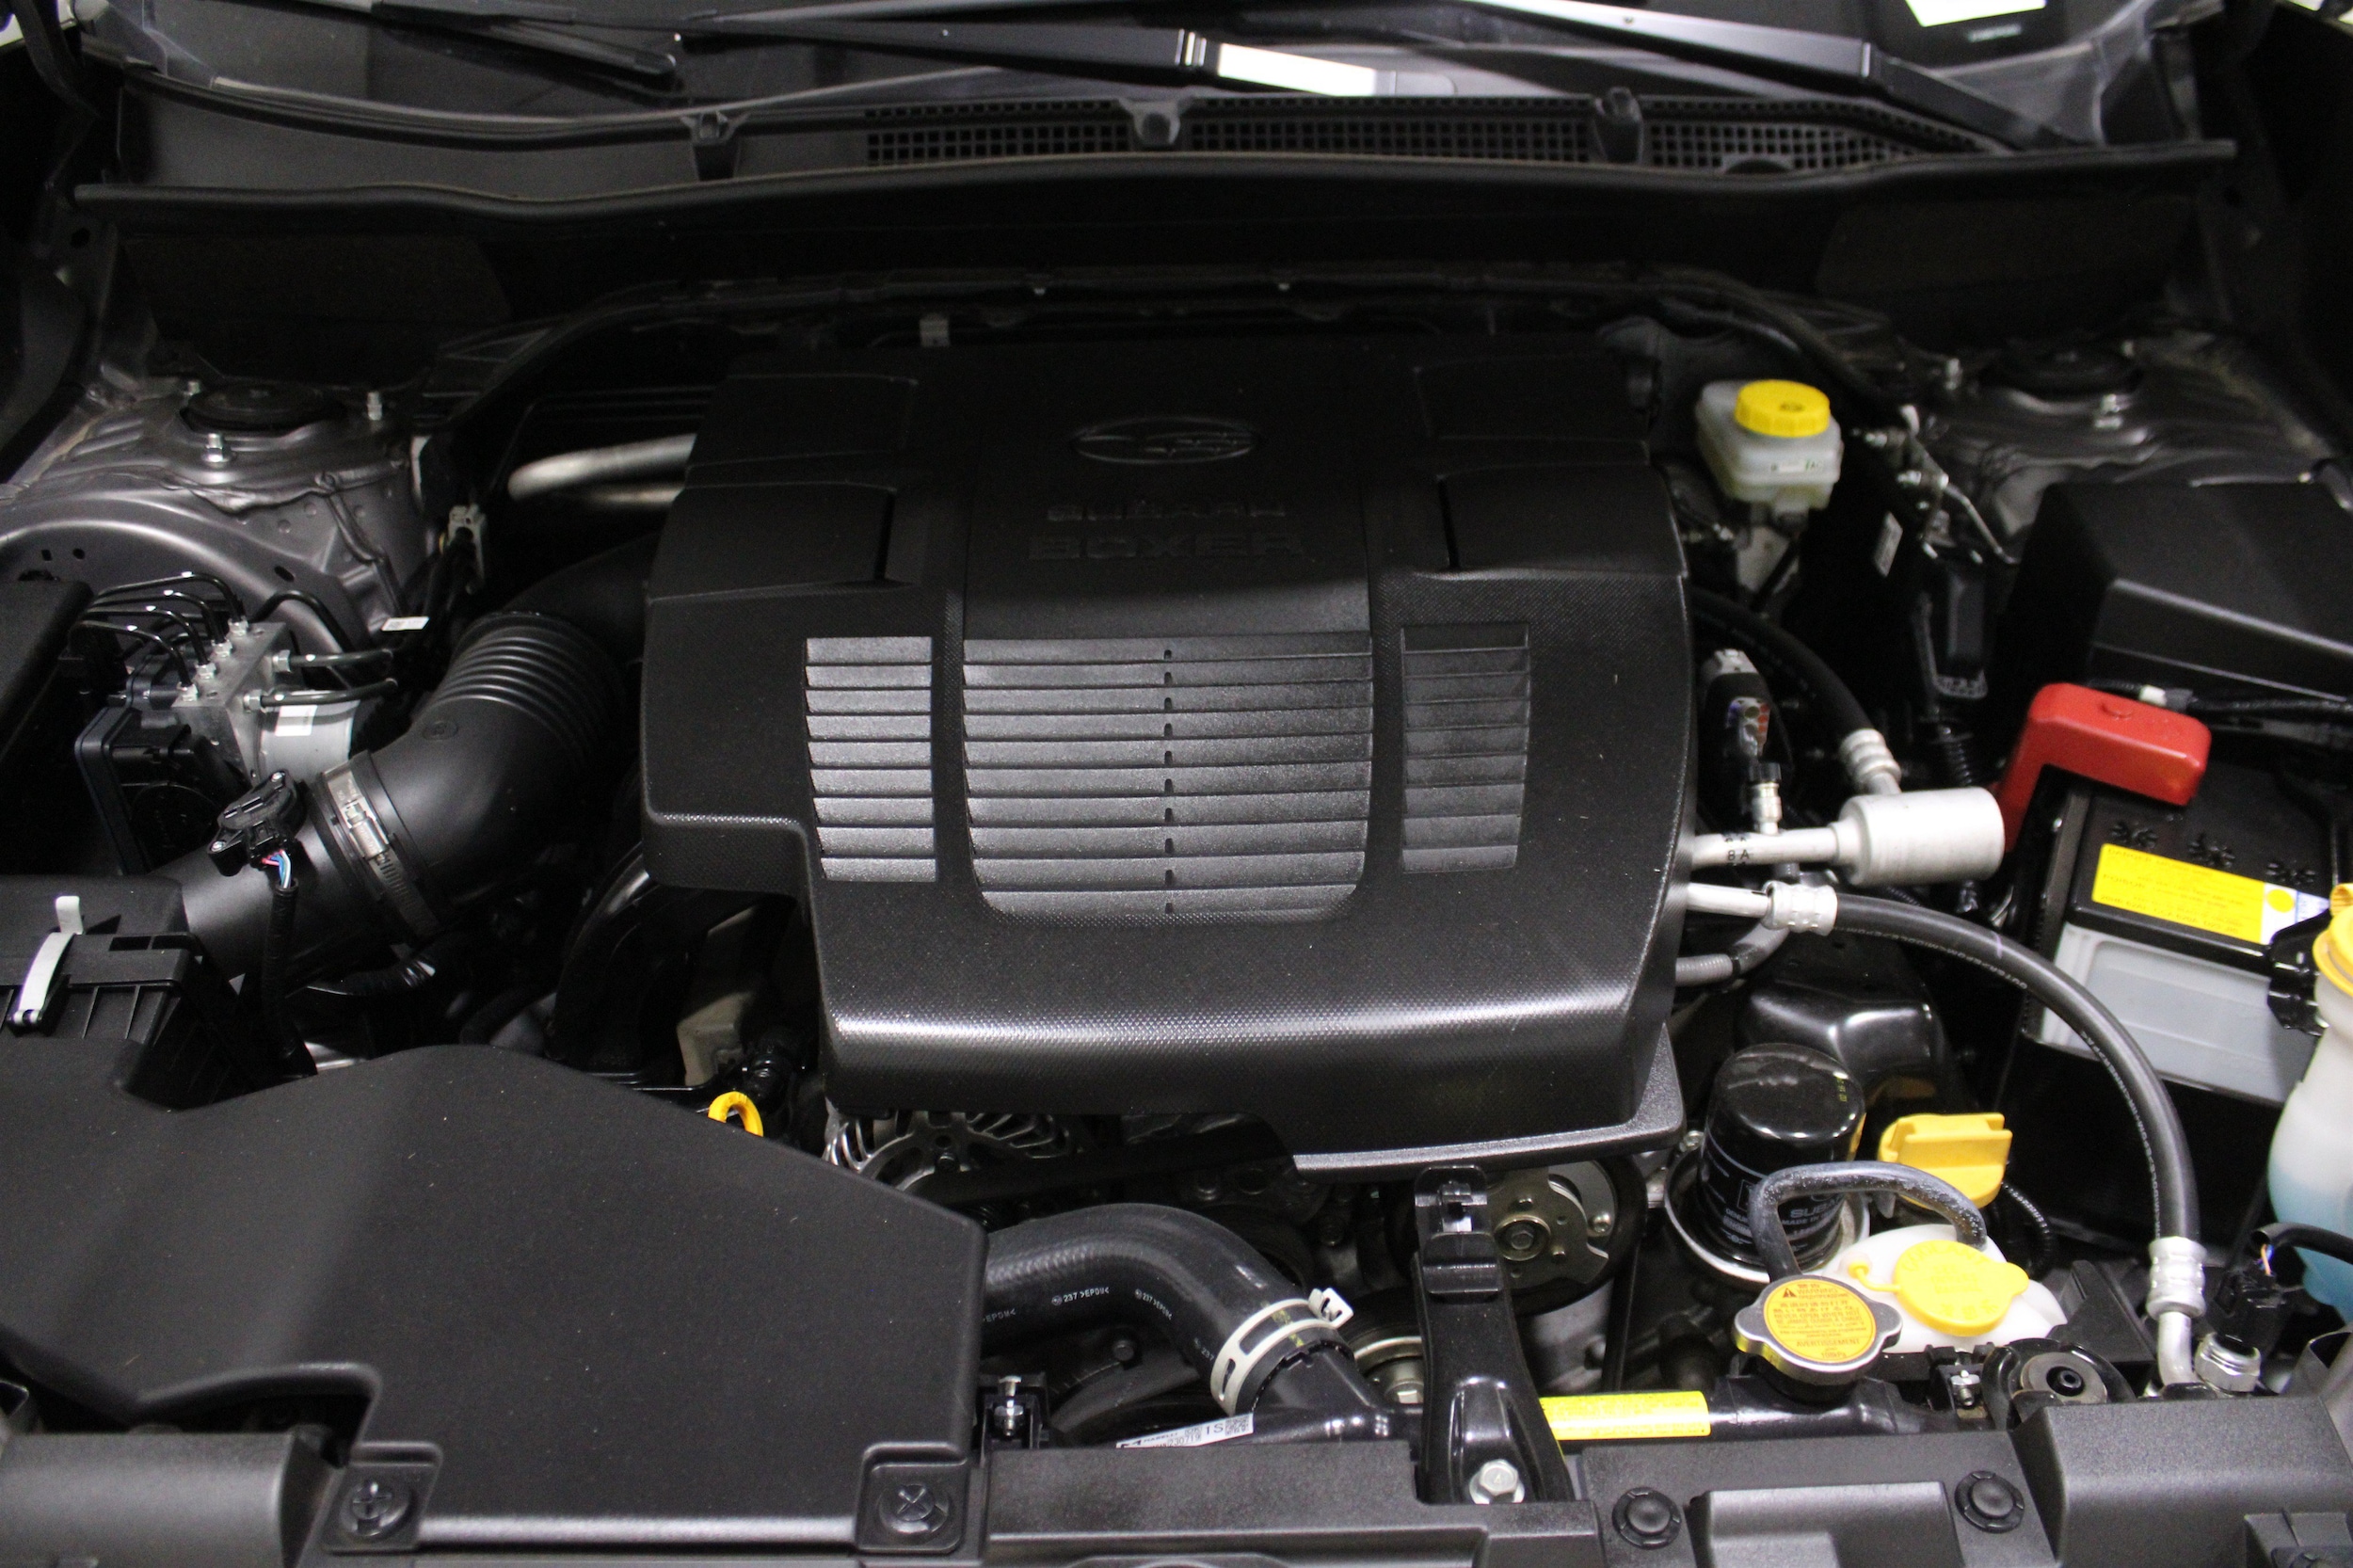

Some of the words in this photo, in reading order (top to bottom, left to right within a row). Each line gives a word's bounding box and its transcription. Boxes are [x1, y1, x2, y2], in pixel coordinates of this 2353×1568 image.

[1028, 535, 1305, 560] BOXER
[1063, 1291, 1079, 1304] 237
[1142, 1291, 1153, 1304] 237
[1796, 1338, 1861, 1348] AVERTISSEMENT
